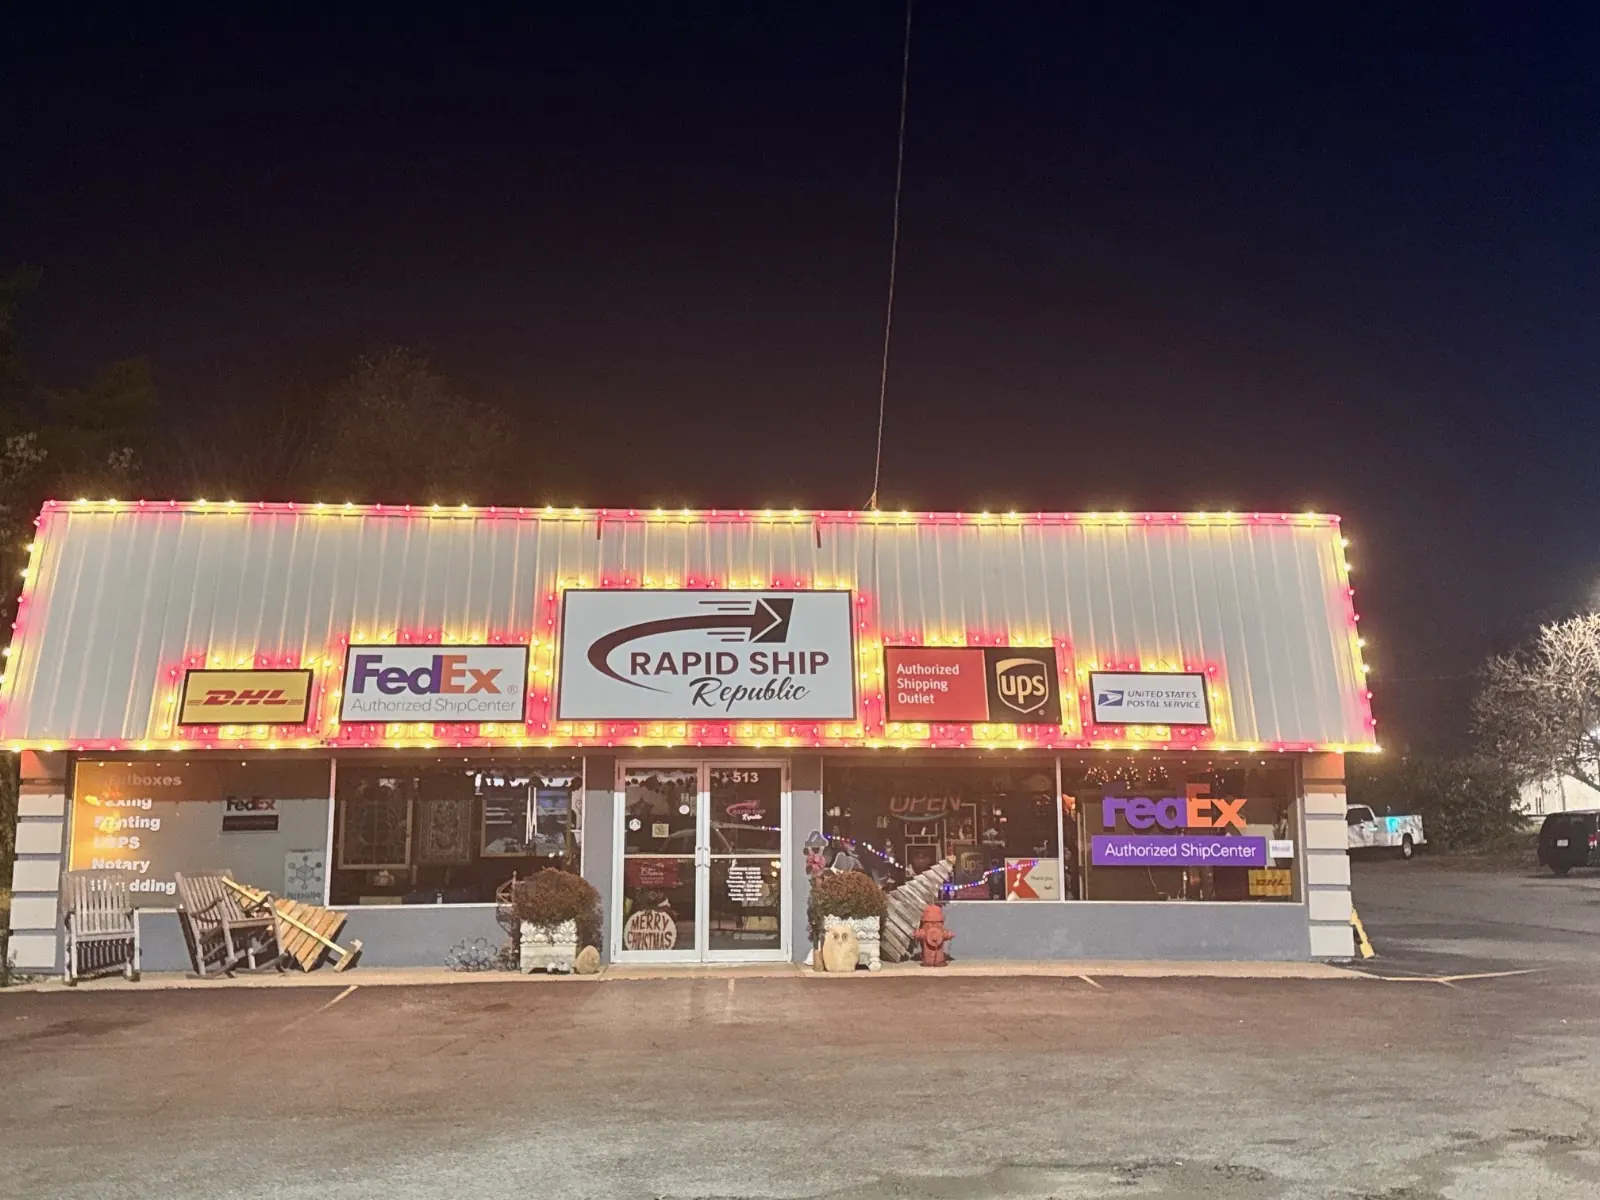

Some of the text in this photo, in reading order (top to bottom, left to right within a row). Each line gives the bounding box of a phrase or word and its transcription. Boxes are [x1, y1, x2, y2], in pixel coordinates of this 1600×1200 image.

[630, 651, 829, 675] RAPID SHIP
[896, 664, 960, 675] Authorized
[351, 654, 503, 695] FedEx
[897, 678, 949, 692] Shipping
[1001, 675, 1046, 705] ups
[203, 689, 291, 706] DHL
[689, 676, 810, 712] Republic
[898, 693, 935, 704] Outlet
[1127, 690, 1197, 698] UNITED STATES
[350, 698, 516, 714] Authorized ShipCenter
[1126, 700, 1200, 709] POSTAL SERVICE
[732, 772, 759, 783] 513
[889, 789, 961, 812] OPEN
[1102, 783, 1249, 829] FedEx
[1105, 843, 1177, 857] Authorized
[1181, 843, 1256, 860] ShipCenter
[91, 857, 150, 874] Notary
[91, 879, 176, 895] dding
[631, 913, 668, 930] MERRY
